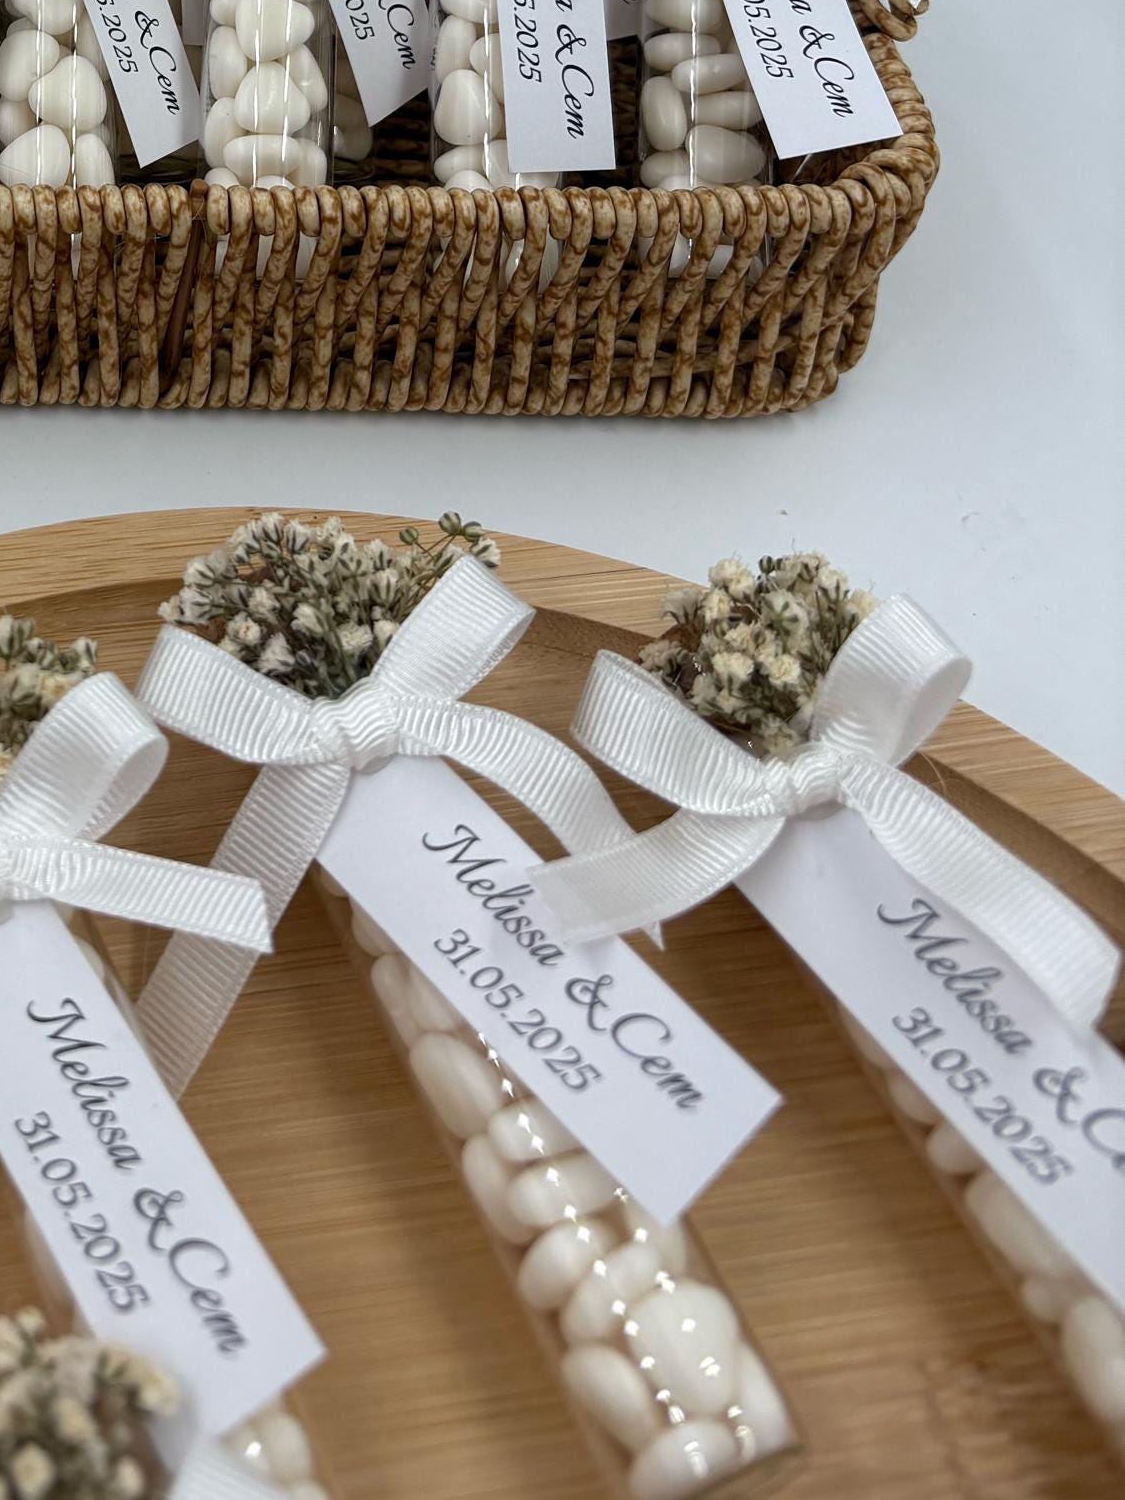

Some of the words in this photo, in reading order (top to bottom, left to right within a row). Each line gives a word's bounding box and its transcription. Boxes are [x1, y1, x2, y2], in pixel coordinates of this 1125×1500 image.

[422, 823, 565, 969] Melissa
[877, 898, 1034, 1055] Melissa
[26, 997, 143, 1172] Melissa
[433, 928, 601, 1093] 31.05.2025
[891, 1006, 1073, 1186] 31.05.2025
[15, 1110, 151, 1316] 31.05.2025
